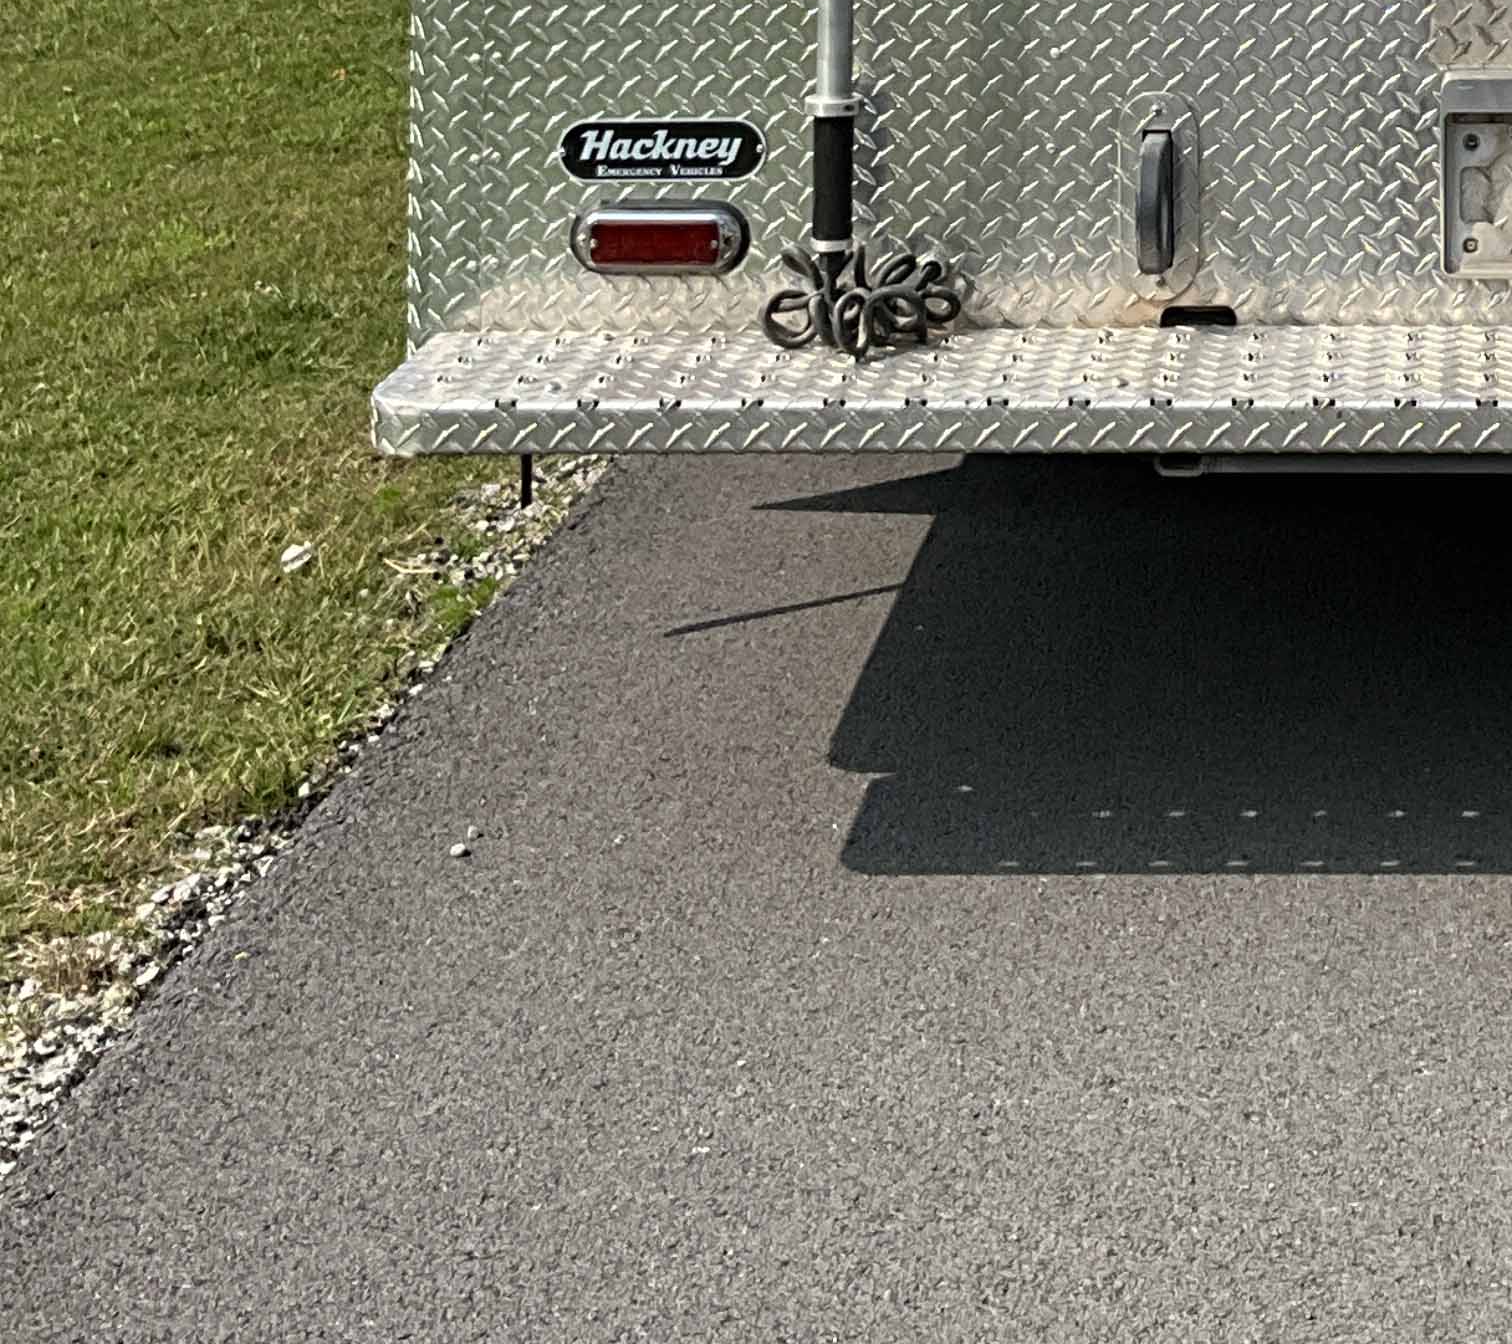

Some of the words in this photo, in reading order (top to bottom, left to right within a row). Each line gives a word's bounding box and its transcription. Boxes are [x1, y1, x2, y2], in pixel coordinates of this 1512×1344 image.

[579, 129, 744, 166] Hackney
[597, 165, 663, 177] EMERGENCY
[670, 164, 724, 177] VEHICLES
